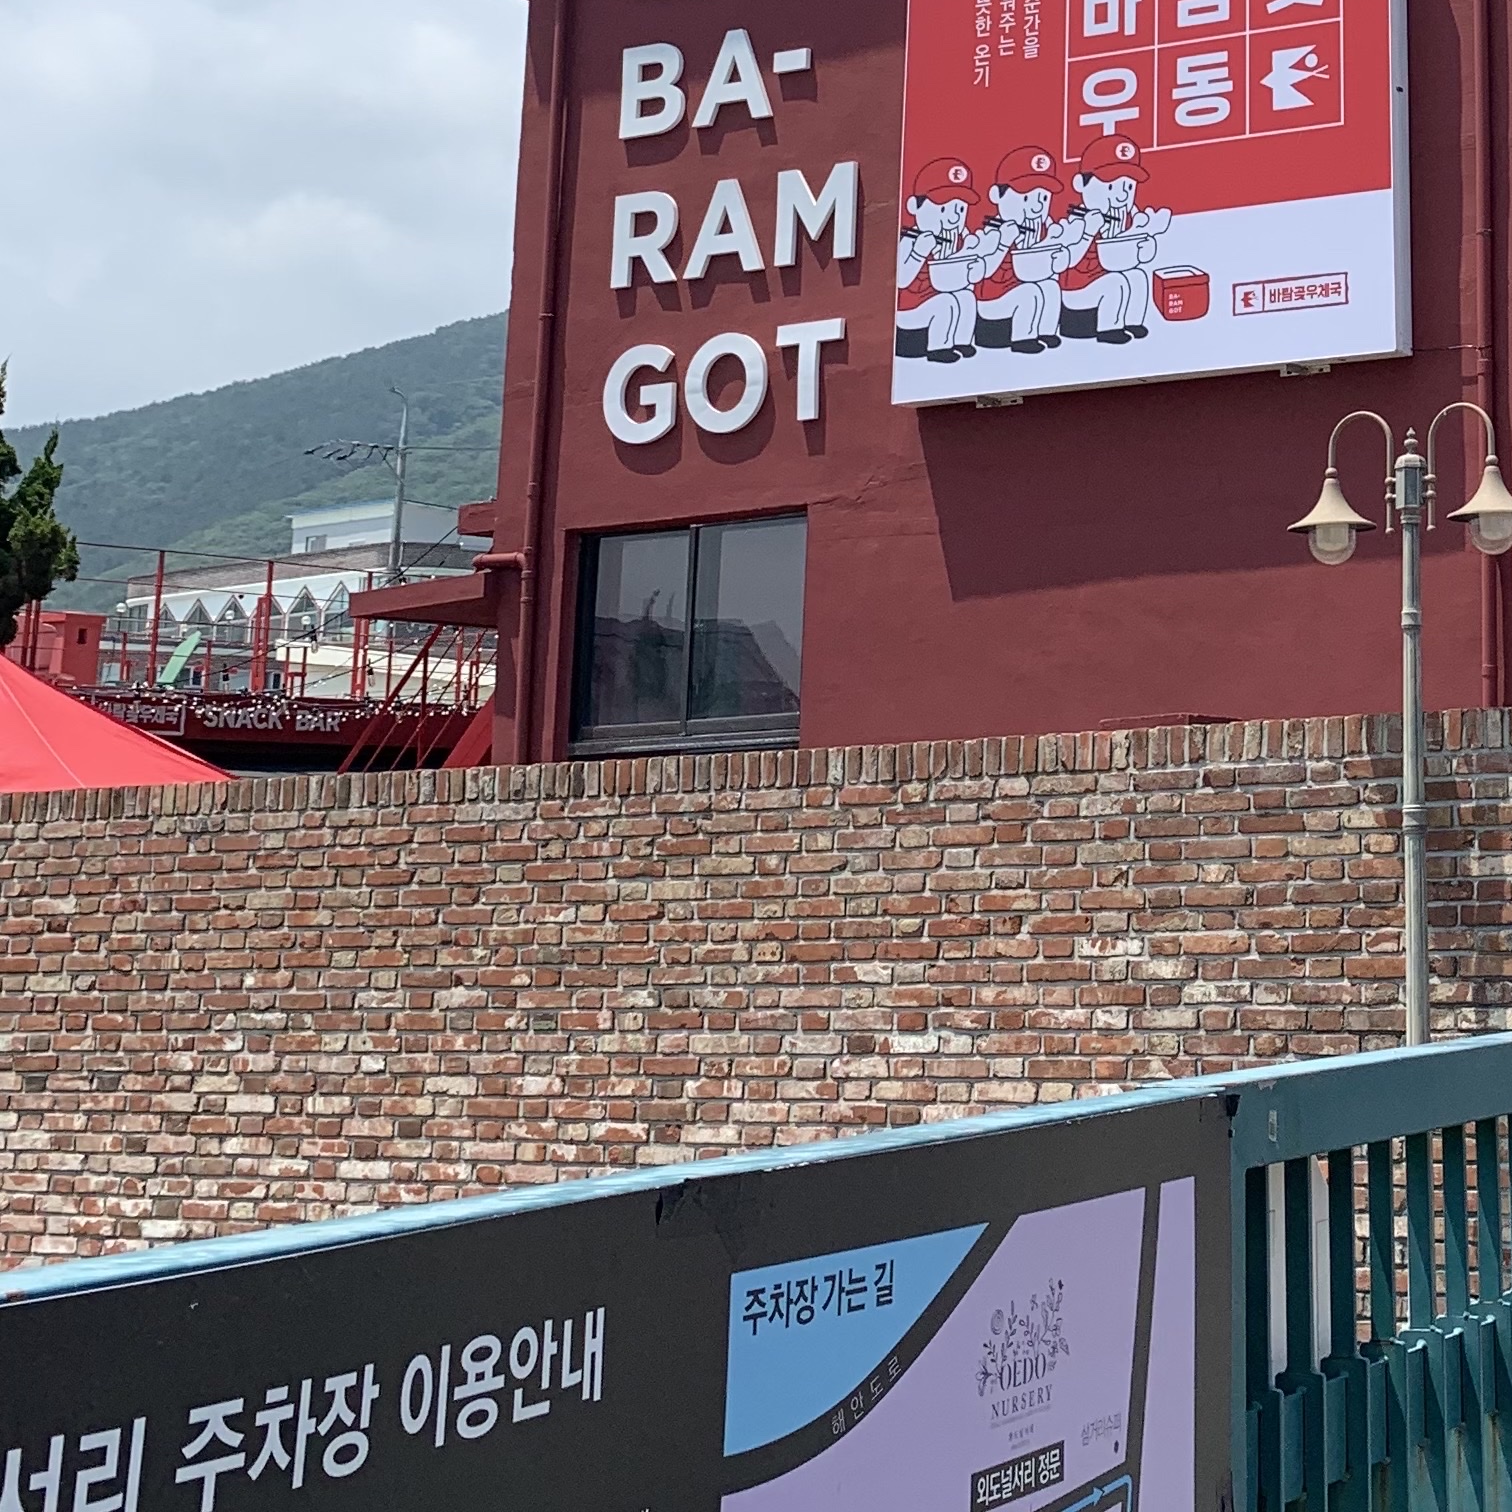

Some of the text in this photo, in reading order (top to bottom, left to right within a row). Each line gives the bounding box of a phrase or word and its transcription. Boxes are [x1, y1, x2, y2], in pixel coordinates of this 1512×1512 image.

[618, 28, 811, 139] BA-
[973, 44, 991, 87] 온기
[1079, 51, 1233, 136] 우동
[609, 161, 859, 289] RAM
[1269, 282, 1342, 303] 바람곶우체국
[603, 318, 846, 444] GOT
[203, 704, 340, 731] SNACK BAR
[743, 1260, 894, 1336] 주차장 가는 길
[175, 1363, 380, 1512] 주차장
[400, 1307, 605, 1447] 이용안내
[832, 1356, 901, 1435] 해안도로
[991, 1384, 1053, 1420] NURSERY
[999, 1353, 1047, 1391] OEDO
[976, 1448, 1061, 1506] 외도널서리 정문
